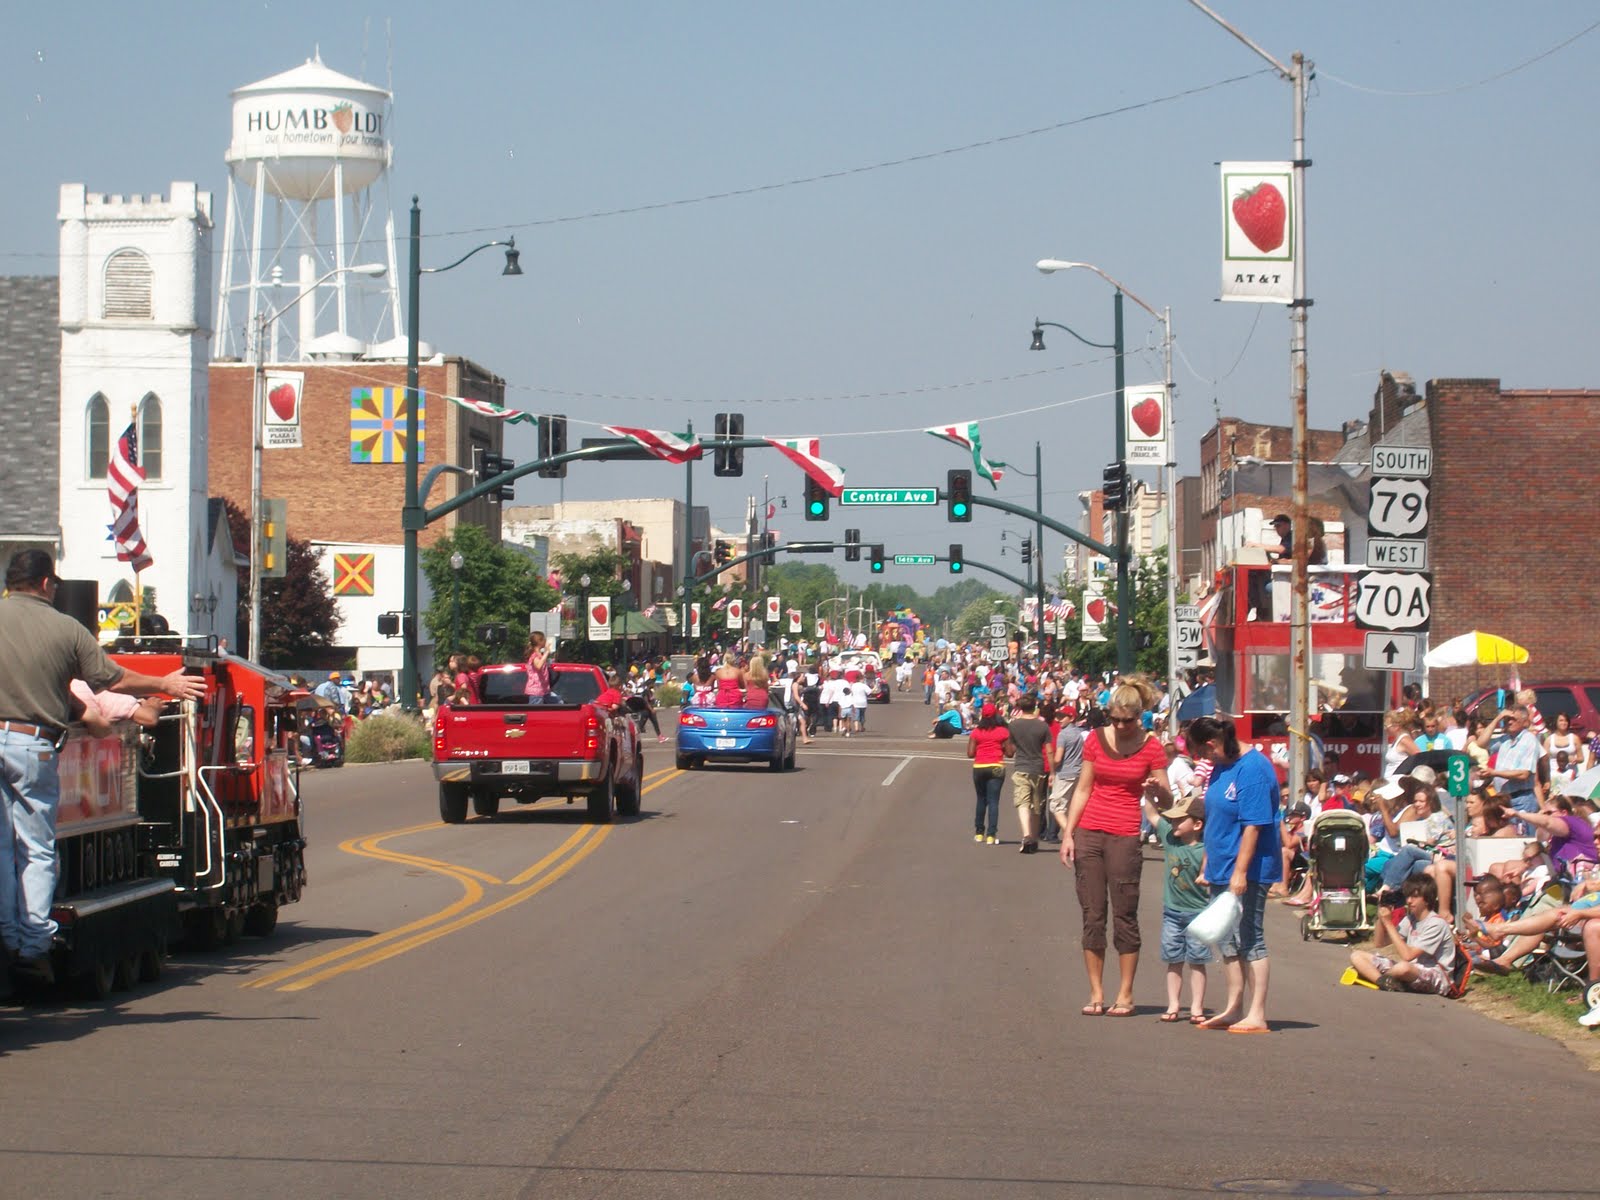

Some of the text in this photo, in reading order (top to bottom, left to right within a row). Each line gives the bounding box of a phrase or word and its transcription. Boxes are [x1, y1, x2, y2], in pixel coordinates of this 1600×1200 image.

[340, 134, 359, 147] your
[1376, 452, 1427, 470] SOUTH
[850, 491, 928, 502] Central Ave
[1377, 491, 1422, 523] 79
[1375, 545, 1418, 563] WEST
[1364, 585, 1425, 617] 70A
[1175, 608, 1200, 617] ORTH
[992, 626, 1003, 634] 79
[1179, 627, 1201, 642] 5W
[991, 650, 1007, 658] 70A
[1452, 759, 1466, 782] 3
